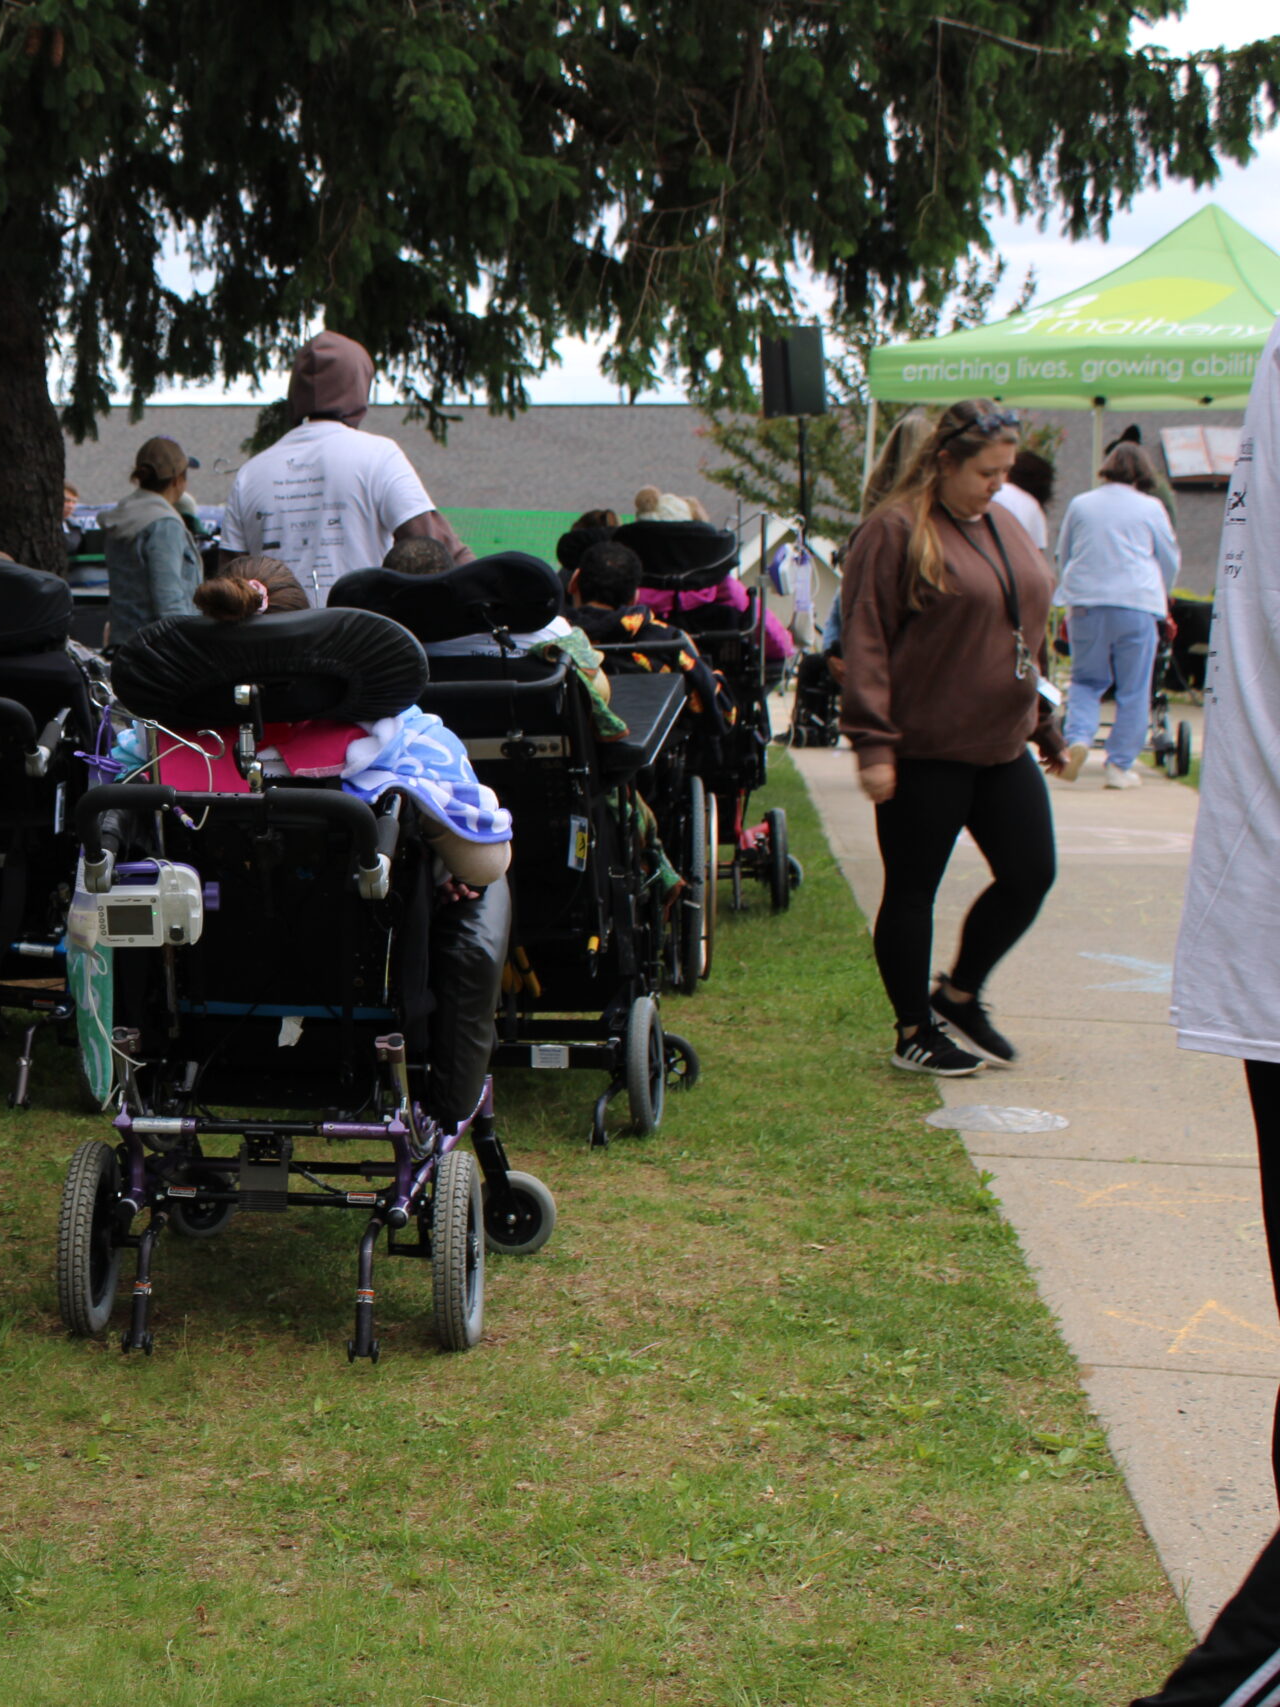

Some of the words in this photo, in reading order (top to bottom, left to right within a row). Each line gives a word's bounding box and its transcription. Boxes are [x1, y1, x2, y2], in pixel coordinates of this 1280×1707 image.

[1046, 316, 1272, 339] matheny
[902, 357, 1010, 385] enriching
[1016, 356, 1075, 379] lives.
[1081, 353, 1184, 383] growing
